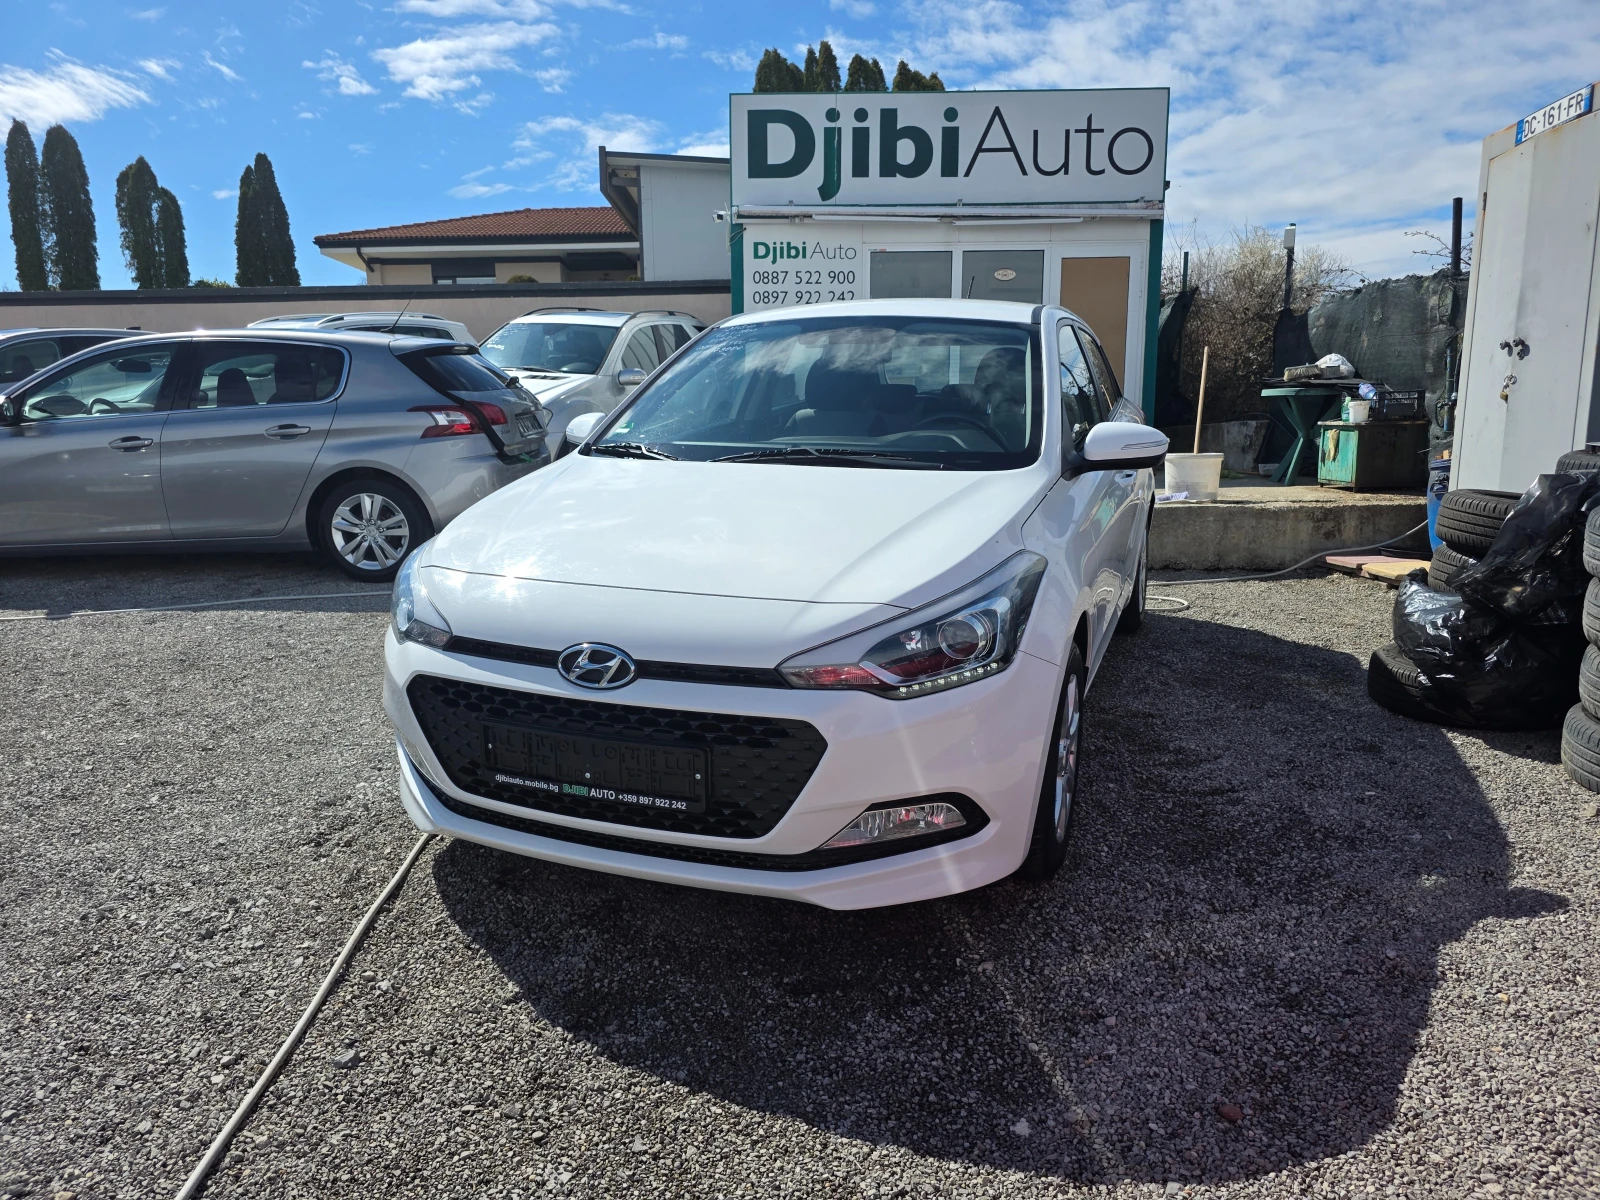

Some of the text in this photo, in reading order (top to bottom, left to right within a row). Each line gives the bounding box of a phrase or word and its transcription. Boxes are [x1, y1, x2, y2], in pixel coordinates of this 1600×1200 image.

[752, 270, 856, 285] 0887 522 900
[752, 290, 788, 305] 0897
[795, 290, 822, 305] 922
[495, 773, 687, 810] djibiauto.mobile.bg DJIBI AUTO +359 897 922 242
